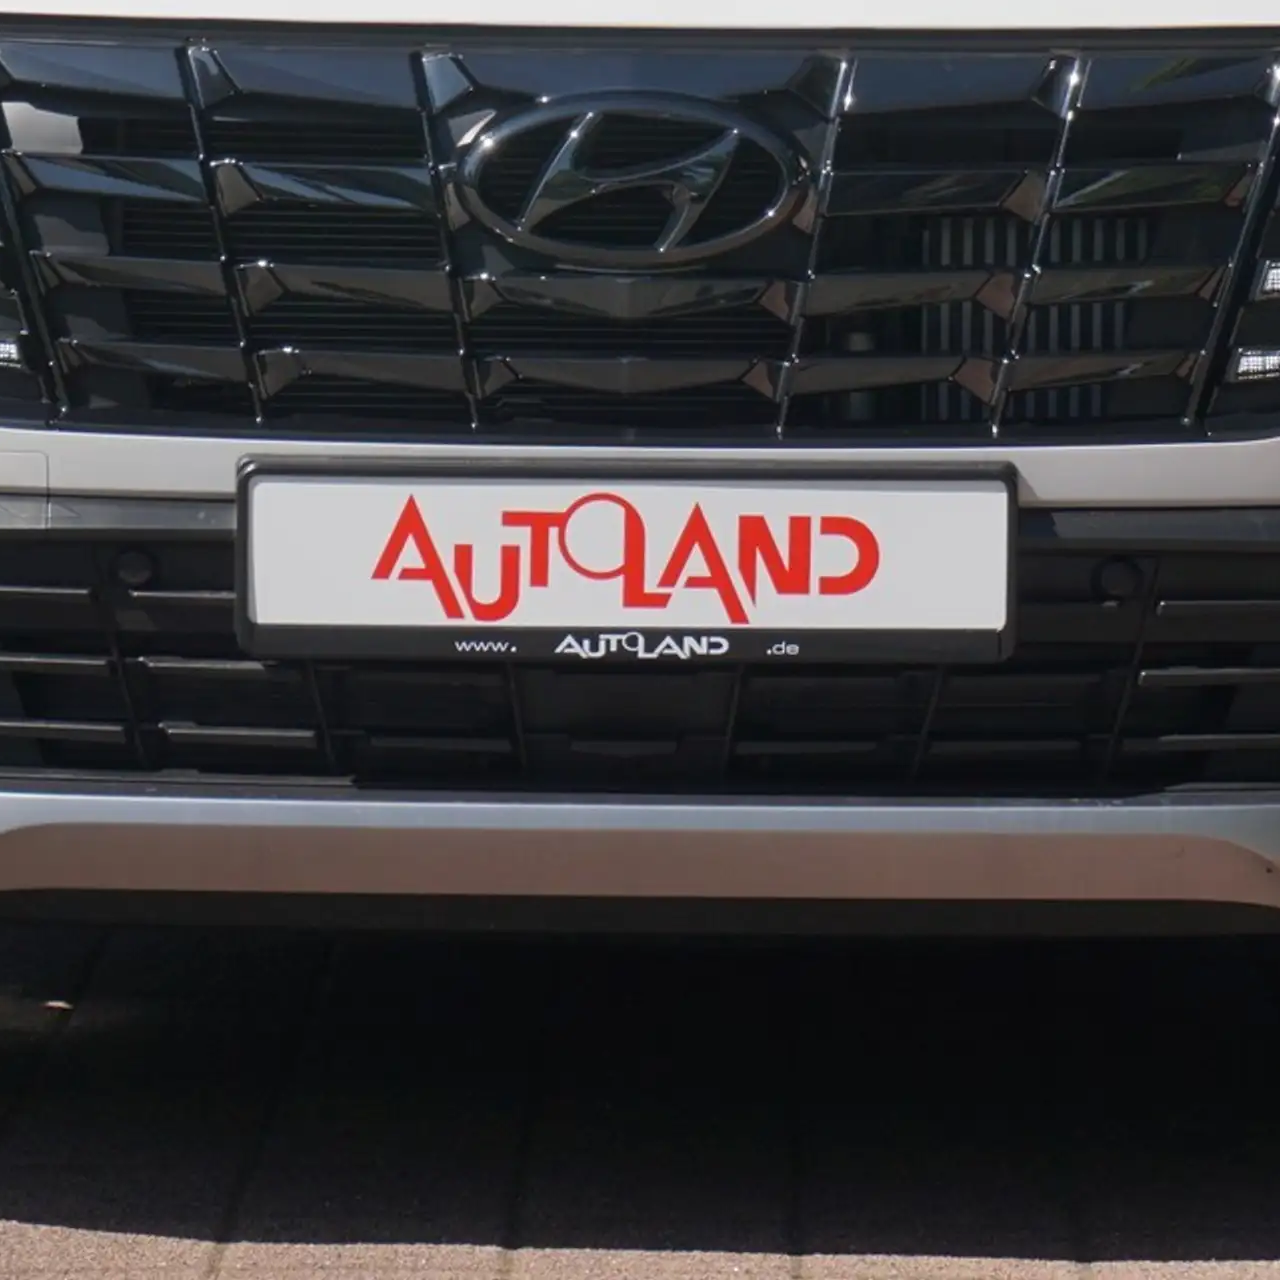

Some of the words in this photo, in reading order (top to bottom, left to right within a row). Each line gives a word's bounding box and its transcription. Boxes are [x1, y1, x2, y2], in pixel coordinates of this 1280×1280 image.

[372, 491, 880, 625] AUTOLAND
[454, 640, 517, 652] www.
[554, 631, 730, 659] AUTOLAND
[766, 639, 800, 655] .de
